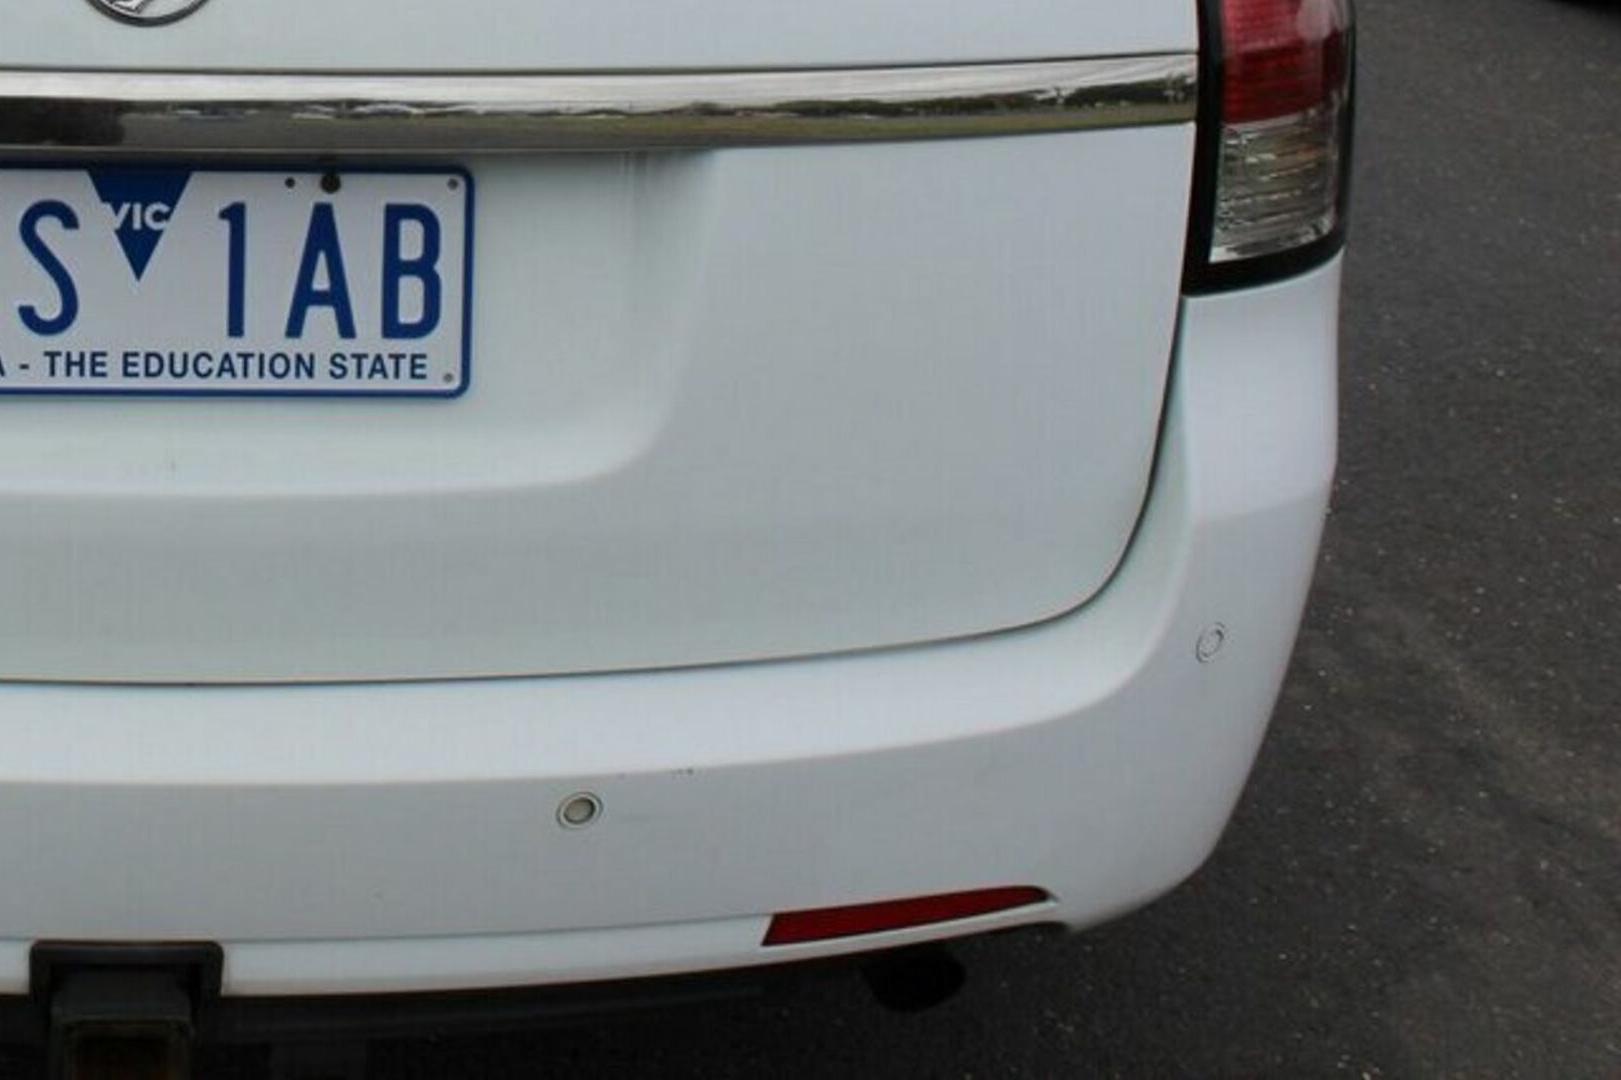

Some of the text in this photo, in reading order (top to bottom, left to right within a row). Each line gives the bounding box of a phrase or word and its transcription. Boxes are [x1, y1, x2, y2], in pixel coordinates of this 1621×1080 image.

[103, 202, 170, 231] VIC
[217, 201, 443, 340] 1AB
[43, 350, 107, 378] THE
[121, 351, 315, 380] EDUCATION
[328, 353, 428, 380] STATE
